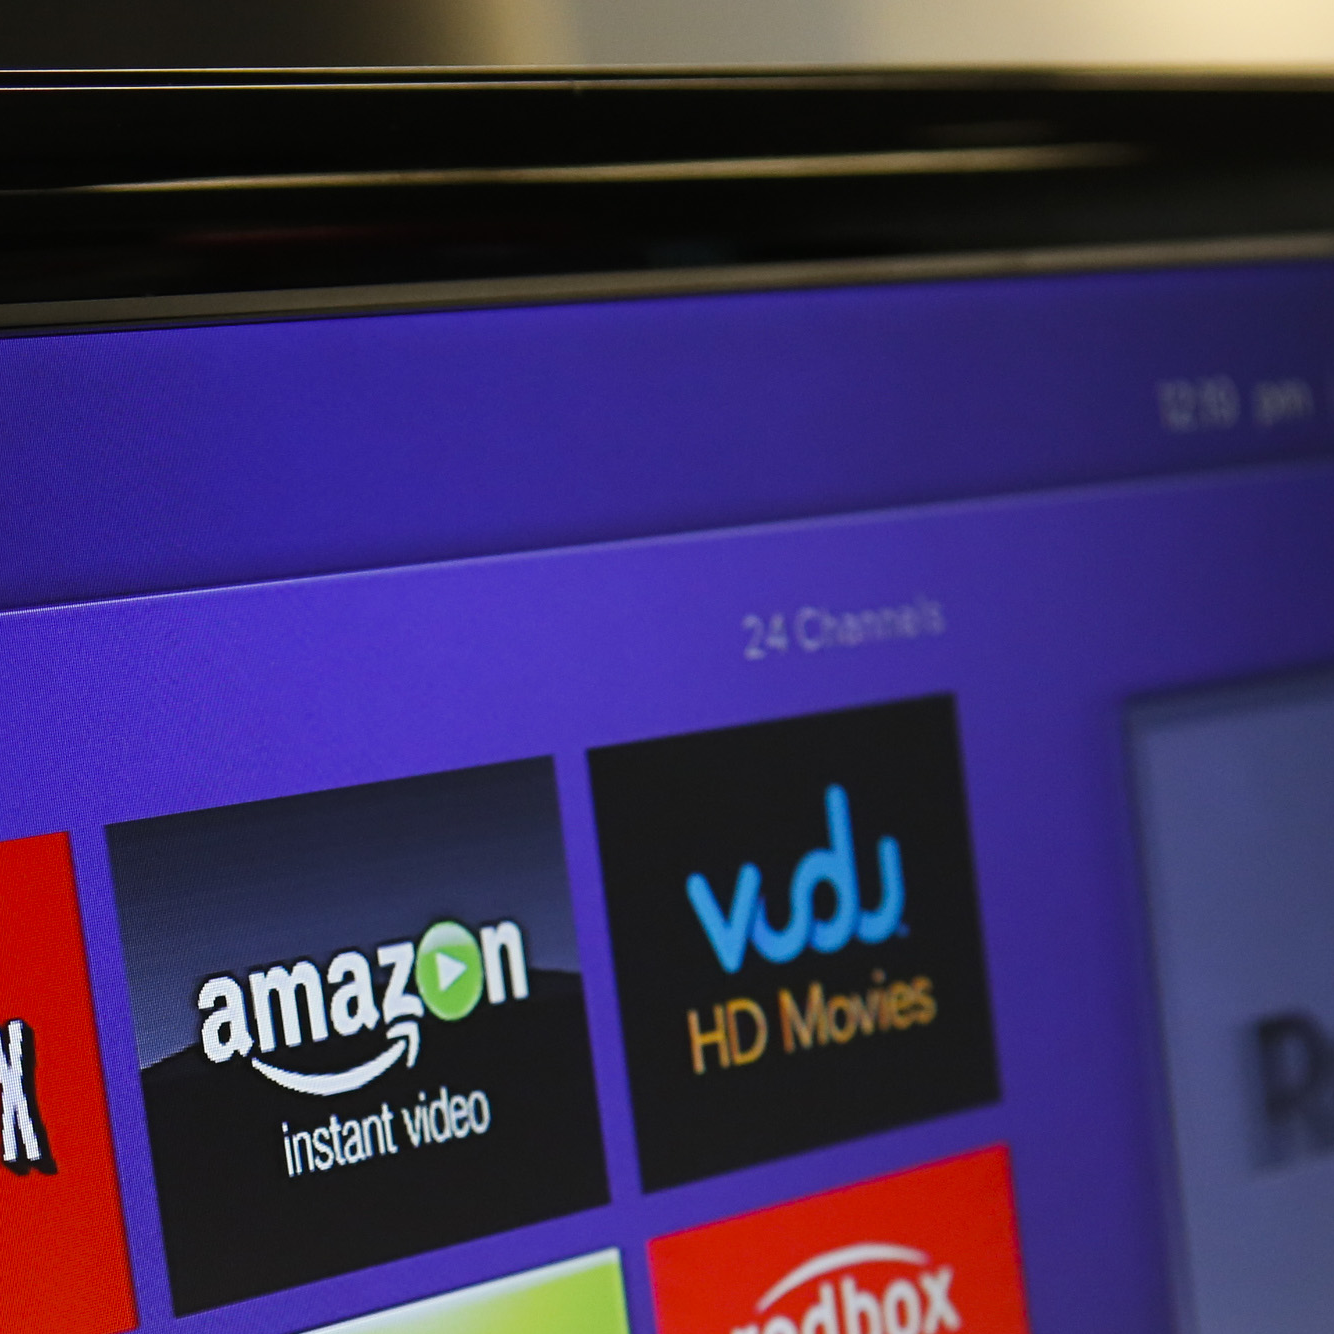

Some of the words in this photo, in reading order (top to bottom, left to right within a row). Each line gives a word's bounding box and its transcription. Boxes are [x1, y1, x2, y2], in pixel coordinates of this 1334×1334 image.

[740, 613, 789, 661] 24
[686, 783, 906, 974] vudu
[197, 920, 529, 1063] amazon
[687, 997, 768, 1075] HD
[778, 967, 937, 1054] Movies
[281, 1102, 399, 1178] instant
[401, 1085, 491, 1148] video
